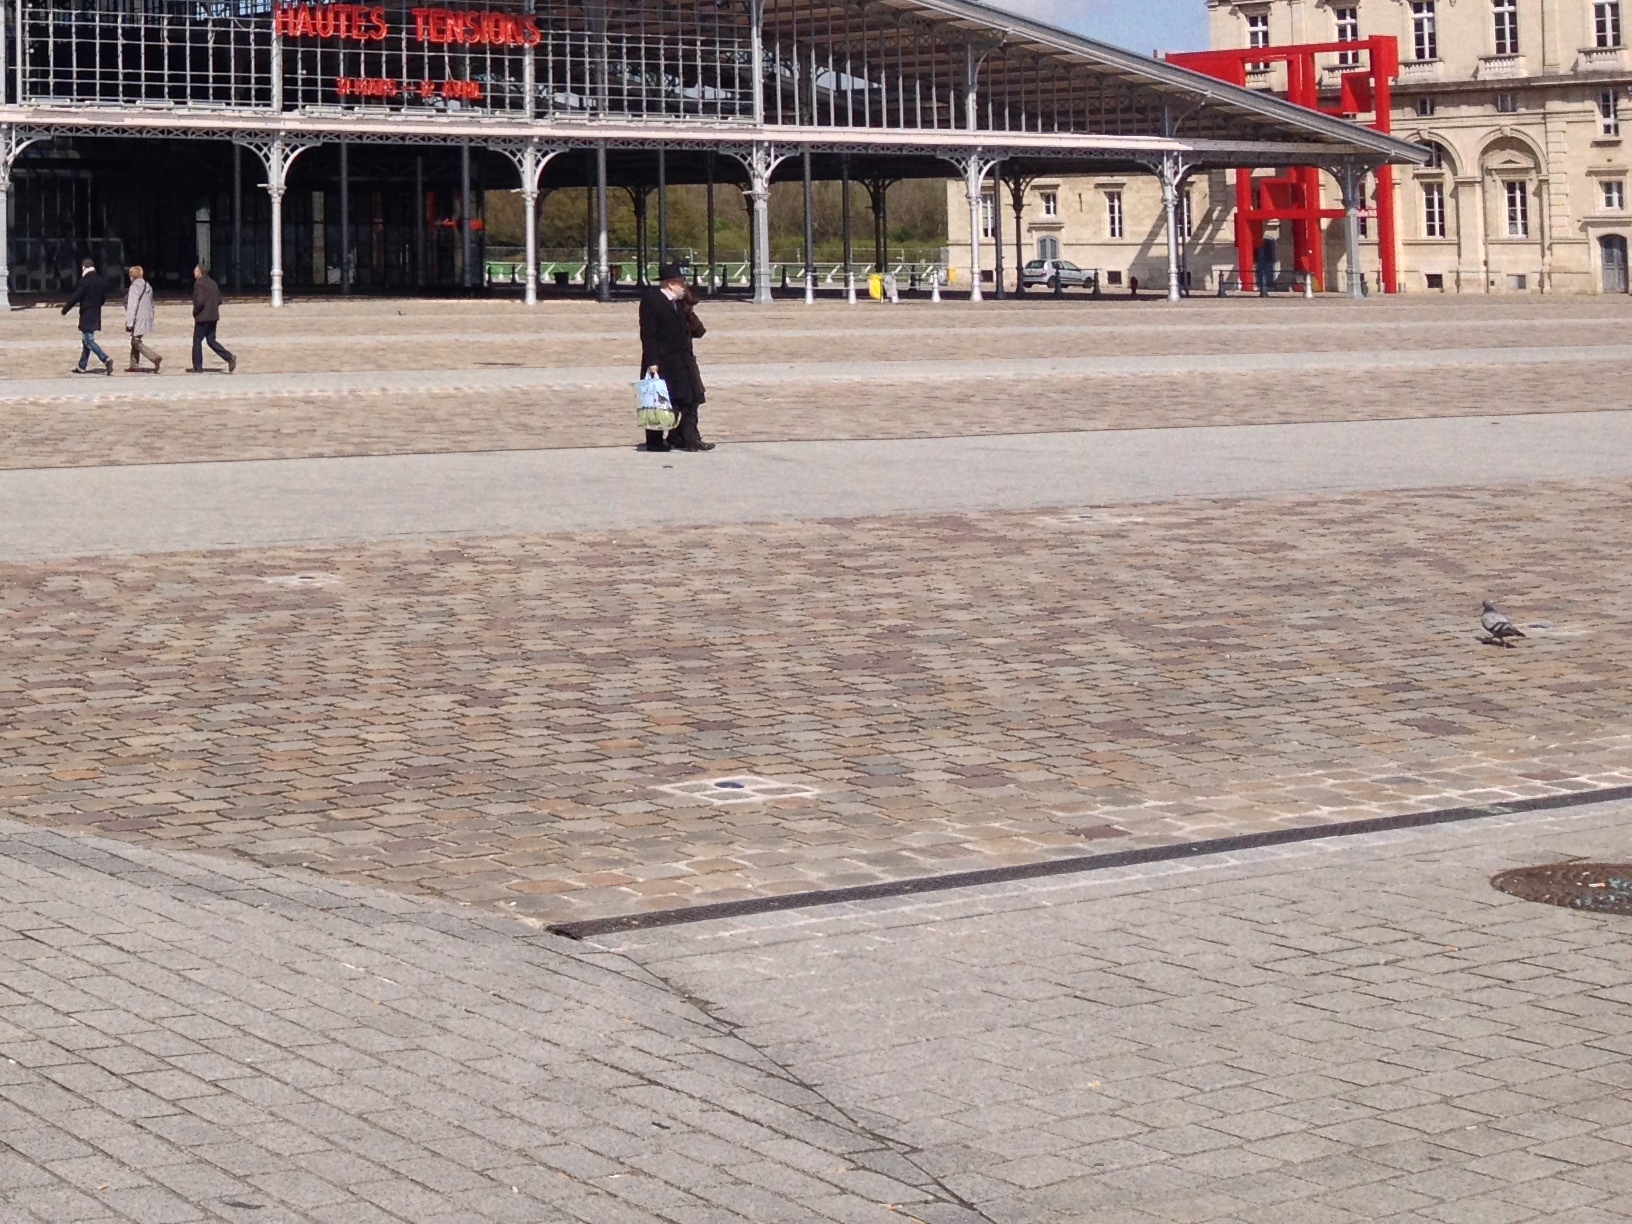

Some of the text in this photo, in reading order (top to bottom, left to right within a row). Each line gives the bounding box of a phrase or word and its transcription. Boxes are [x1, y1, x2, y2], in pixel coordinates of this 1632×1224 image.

[274, 1, 542, 47] HAUTES TENSIONS
[354, 78, 397, 96] MARS
